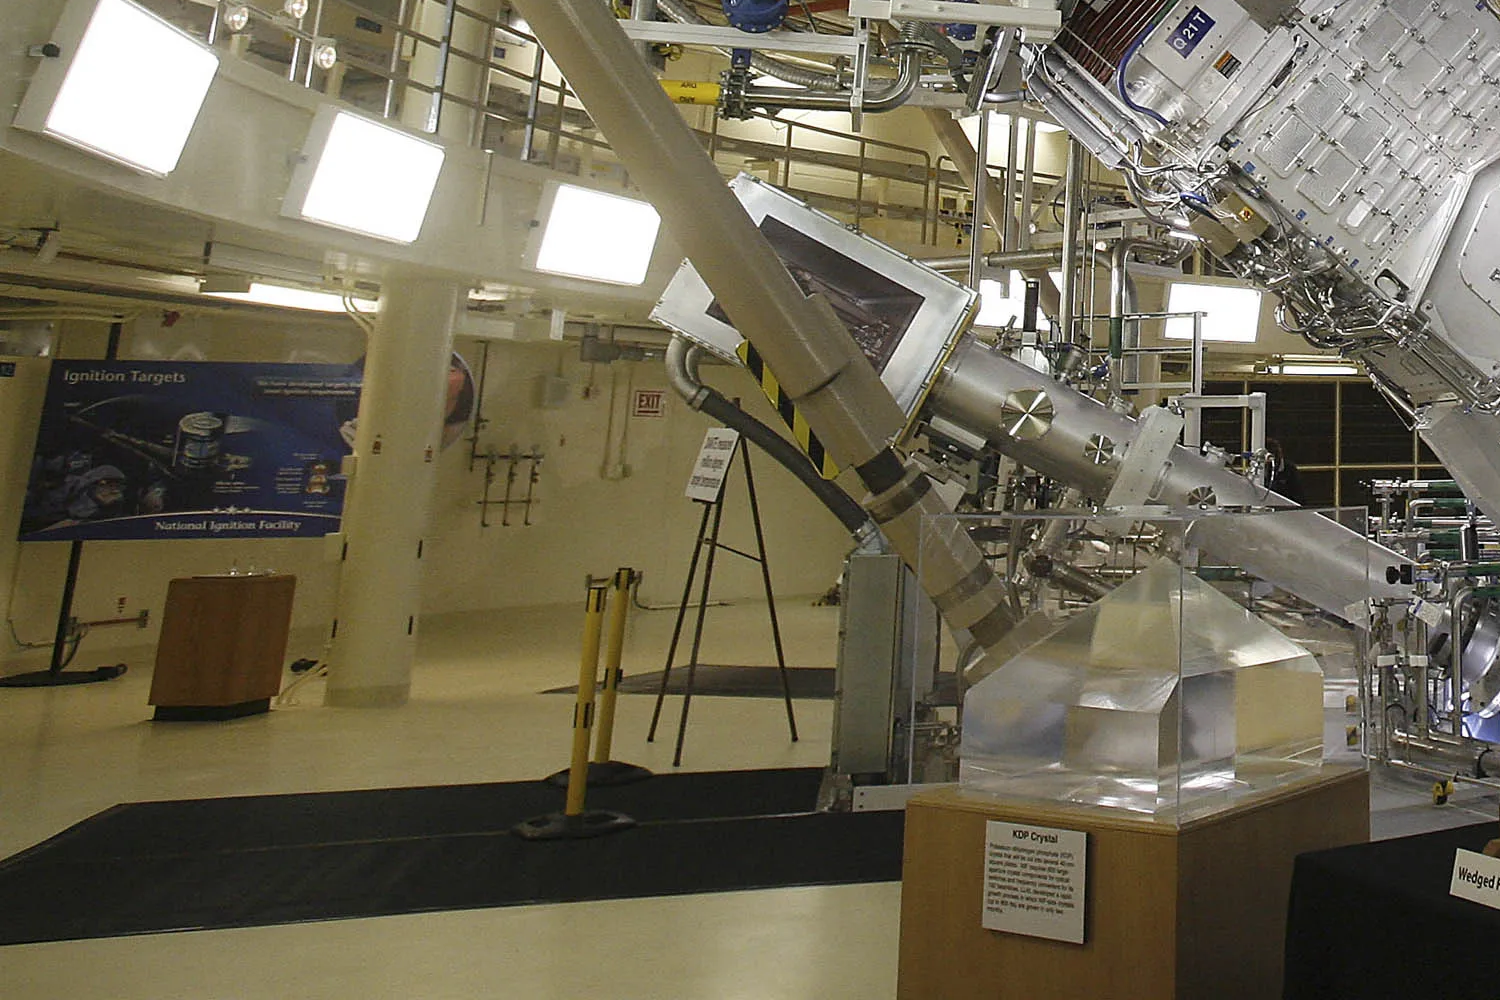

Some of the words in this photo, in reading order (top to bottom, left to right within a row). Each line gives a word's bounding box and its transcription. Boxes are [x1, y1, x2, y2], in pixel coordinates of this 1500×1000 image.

[1173, 37, 1187, 50] Q
[1182, 22, 1199, 40] 21
[1193, 11, 1206, 24] T
[64, 369, 125, 385] Ignition
[130, 370, 186, 386] Targets
[639, 394, 661, 409] EXIT
[155, 521, 206, 531] National
[210, 520, 256, 532] Ignition
[259, 520, 301, 532] Facility
[1013, 830, 1029, 840] KDP
[1031, 832, 1058, 844] Crystal
[1458, 867, 1496, 889] Wedged
